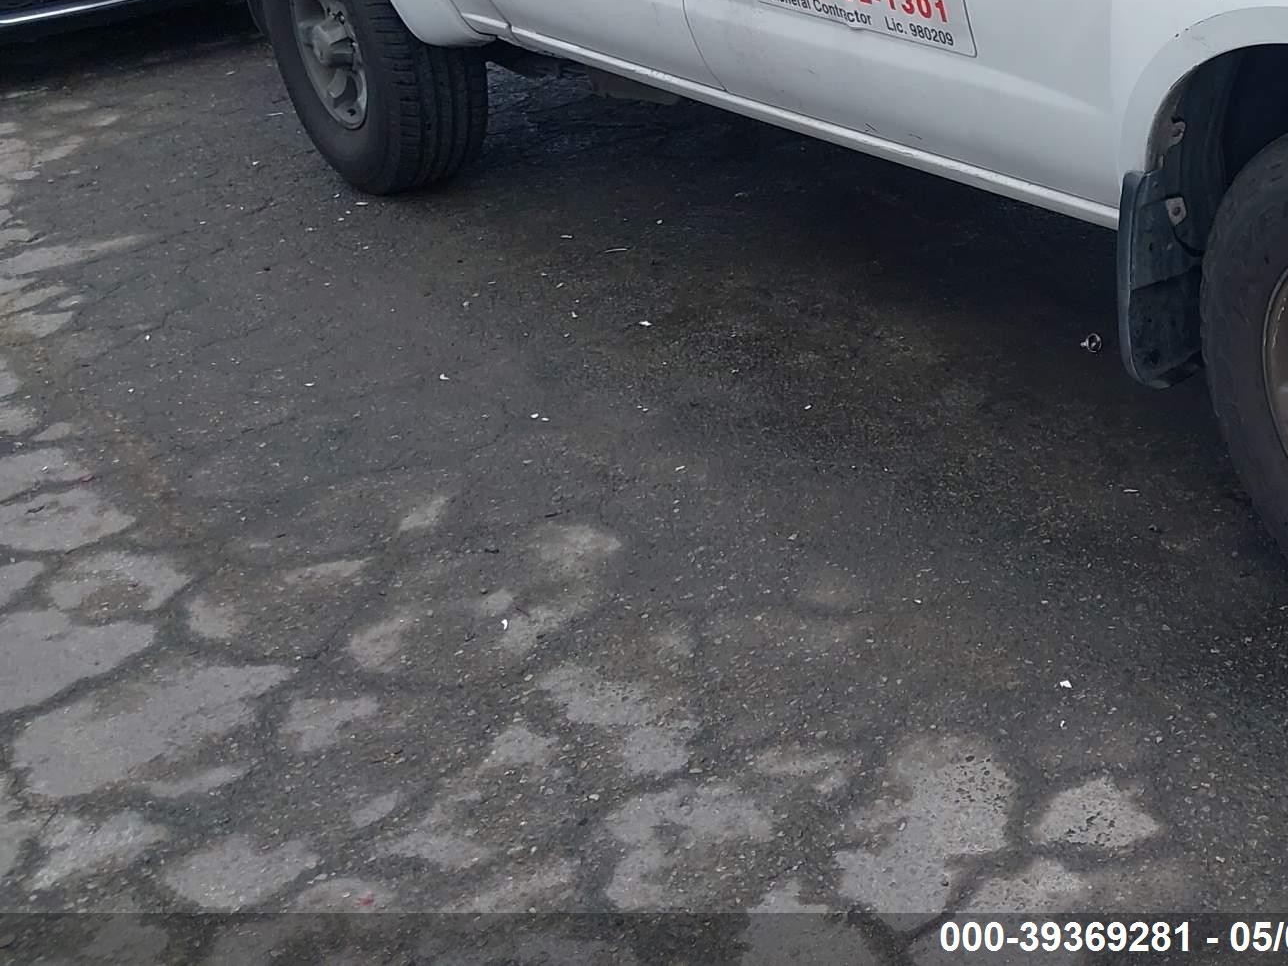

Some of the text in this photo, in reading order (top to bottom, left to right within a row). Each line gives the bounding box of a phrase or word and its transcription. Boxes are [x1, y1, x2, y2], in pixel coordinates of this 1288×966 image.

[813, 0, 873, 27] Contractor
[885, 16, 908, 35] Lic.
[910, 20, 955, 46] 980209
